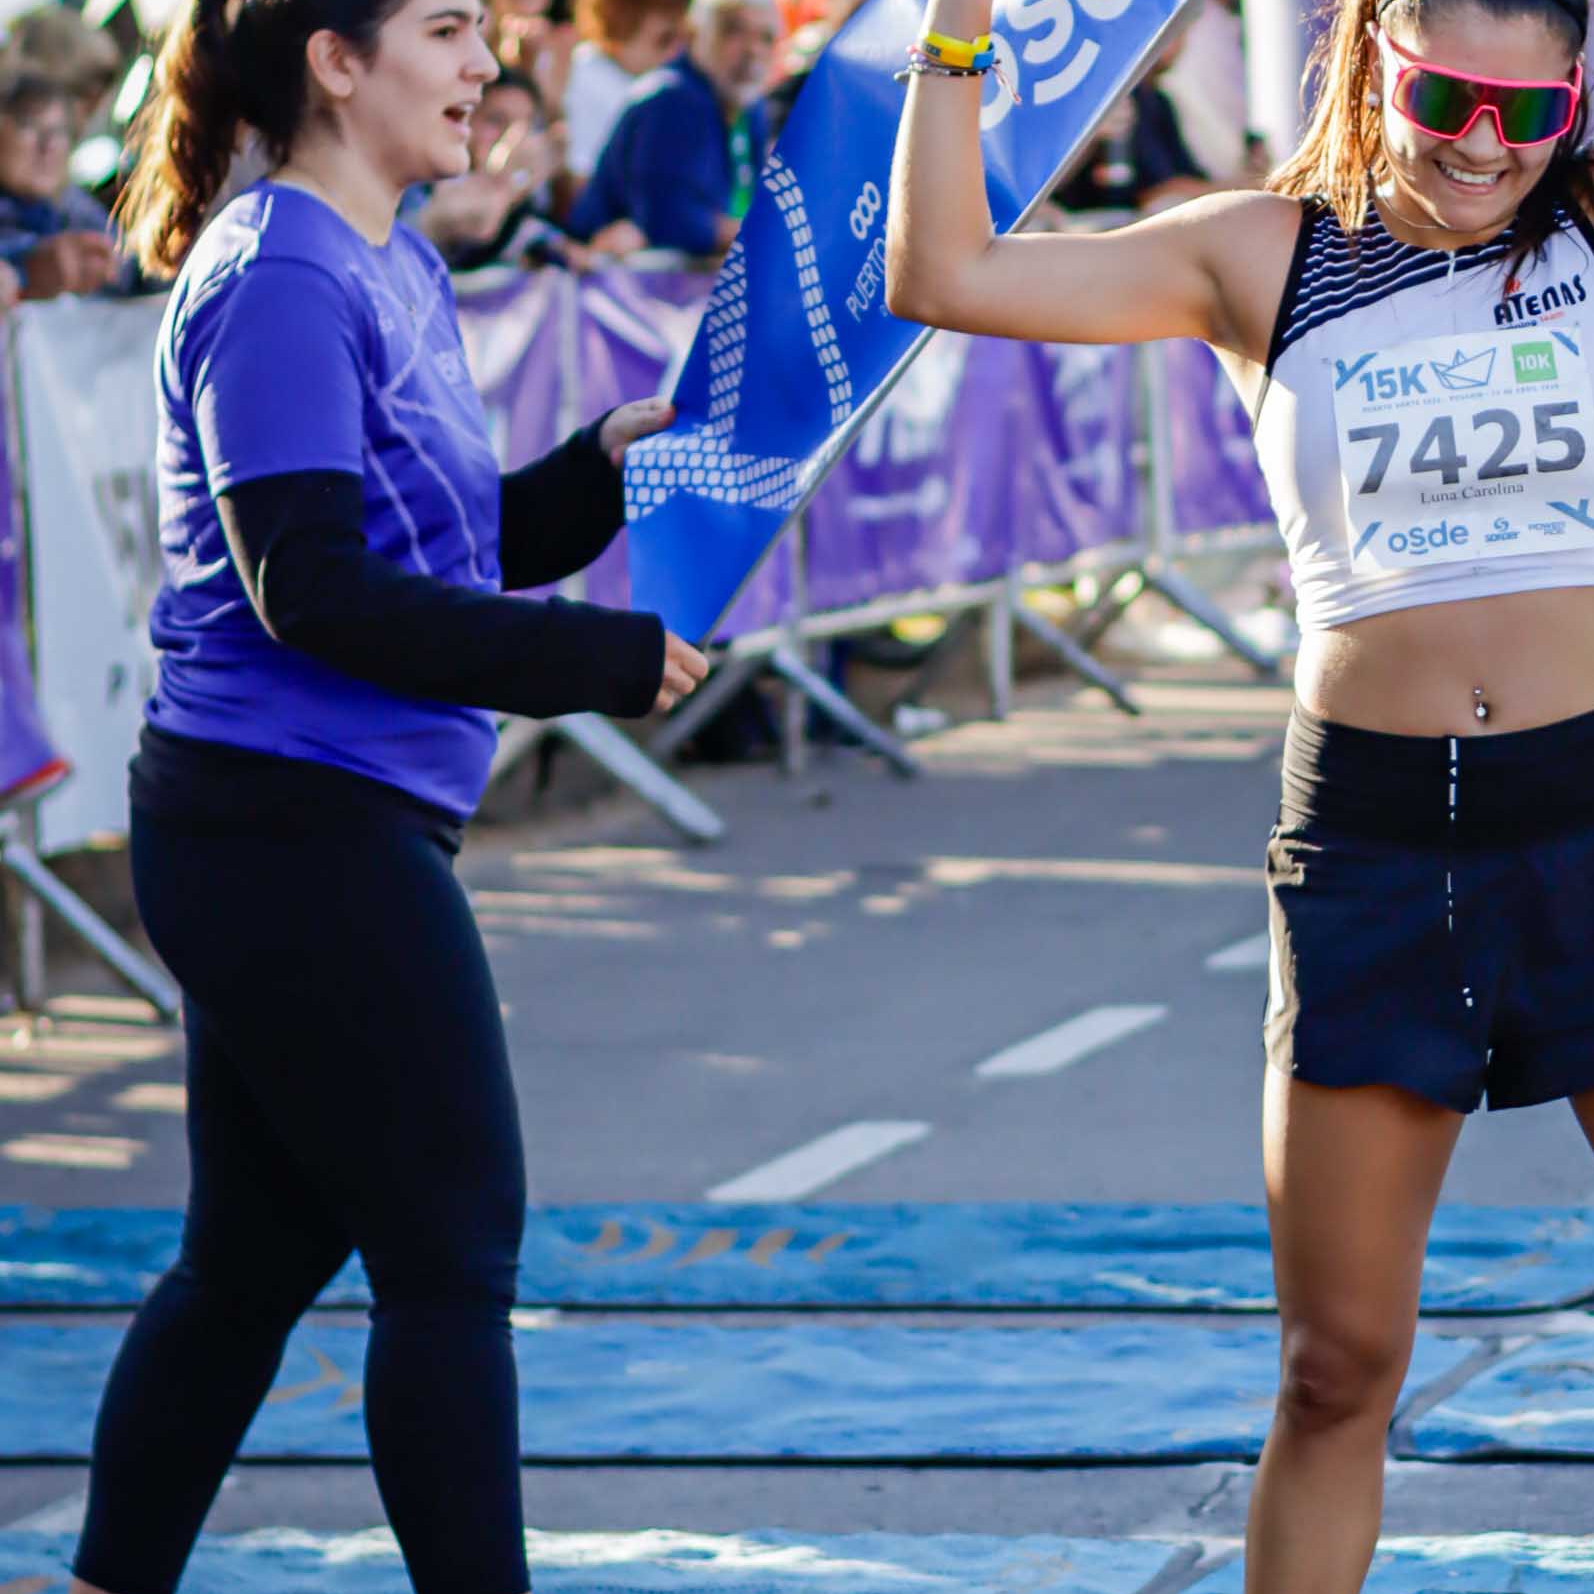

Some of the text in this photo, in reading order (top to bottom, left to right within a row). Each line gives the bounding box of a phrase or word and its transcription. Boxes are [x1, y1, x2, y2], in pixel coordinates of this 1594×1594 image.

[1516, 353, 1551, 371] 10K
[1359, 363, 1428, 402] 15K
[1347, 401, 1587, 496] 7425
[1420, 482, 1525, 505] Luna Carolina
[1388, 518, 1470, 555] osde
